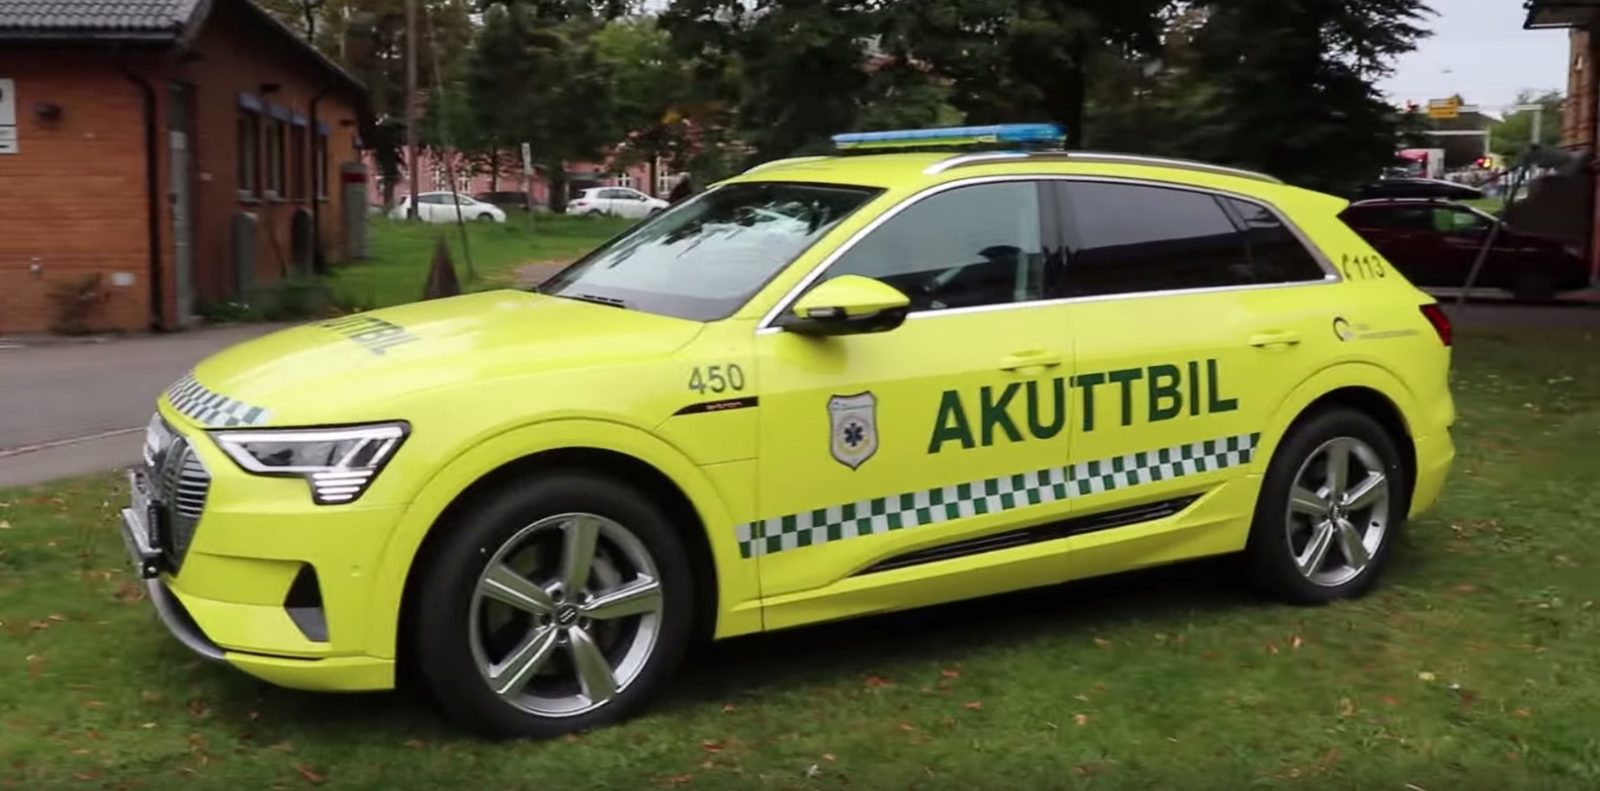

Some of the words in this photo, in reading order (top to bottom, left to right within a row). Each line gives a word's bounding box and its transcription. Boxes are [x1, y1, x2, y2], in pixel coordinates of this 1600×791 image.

[1353, 254, 1385, 279] 113
[688, 363, 745, 395] 450
[928, 358, 1239, 454] AKUTTBIL
